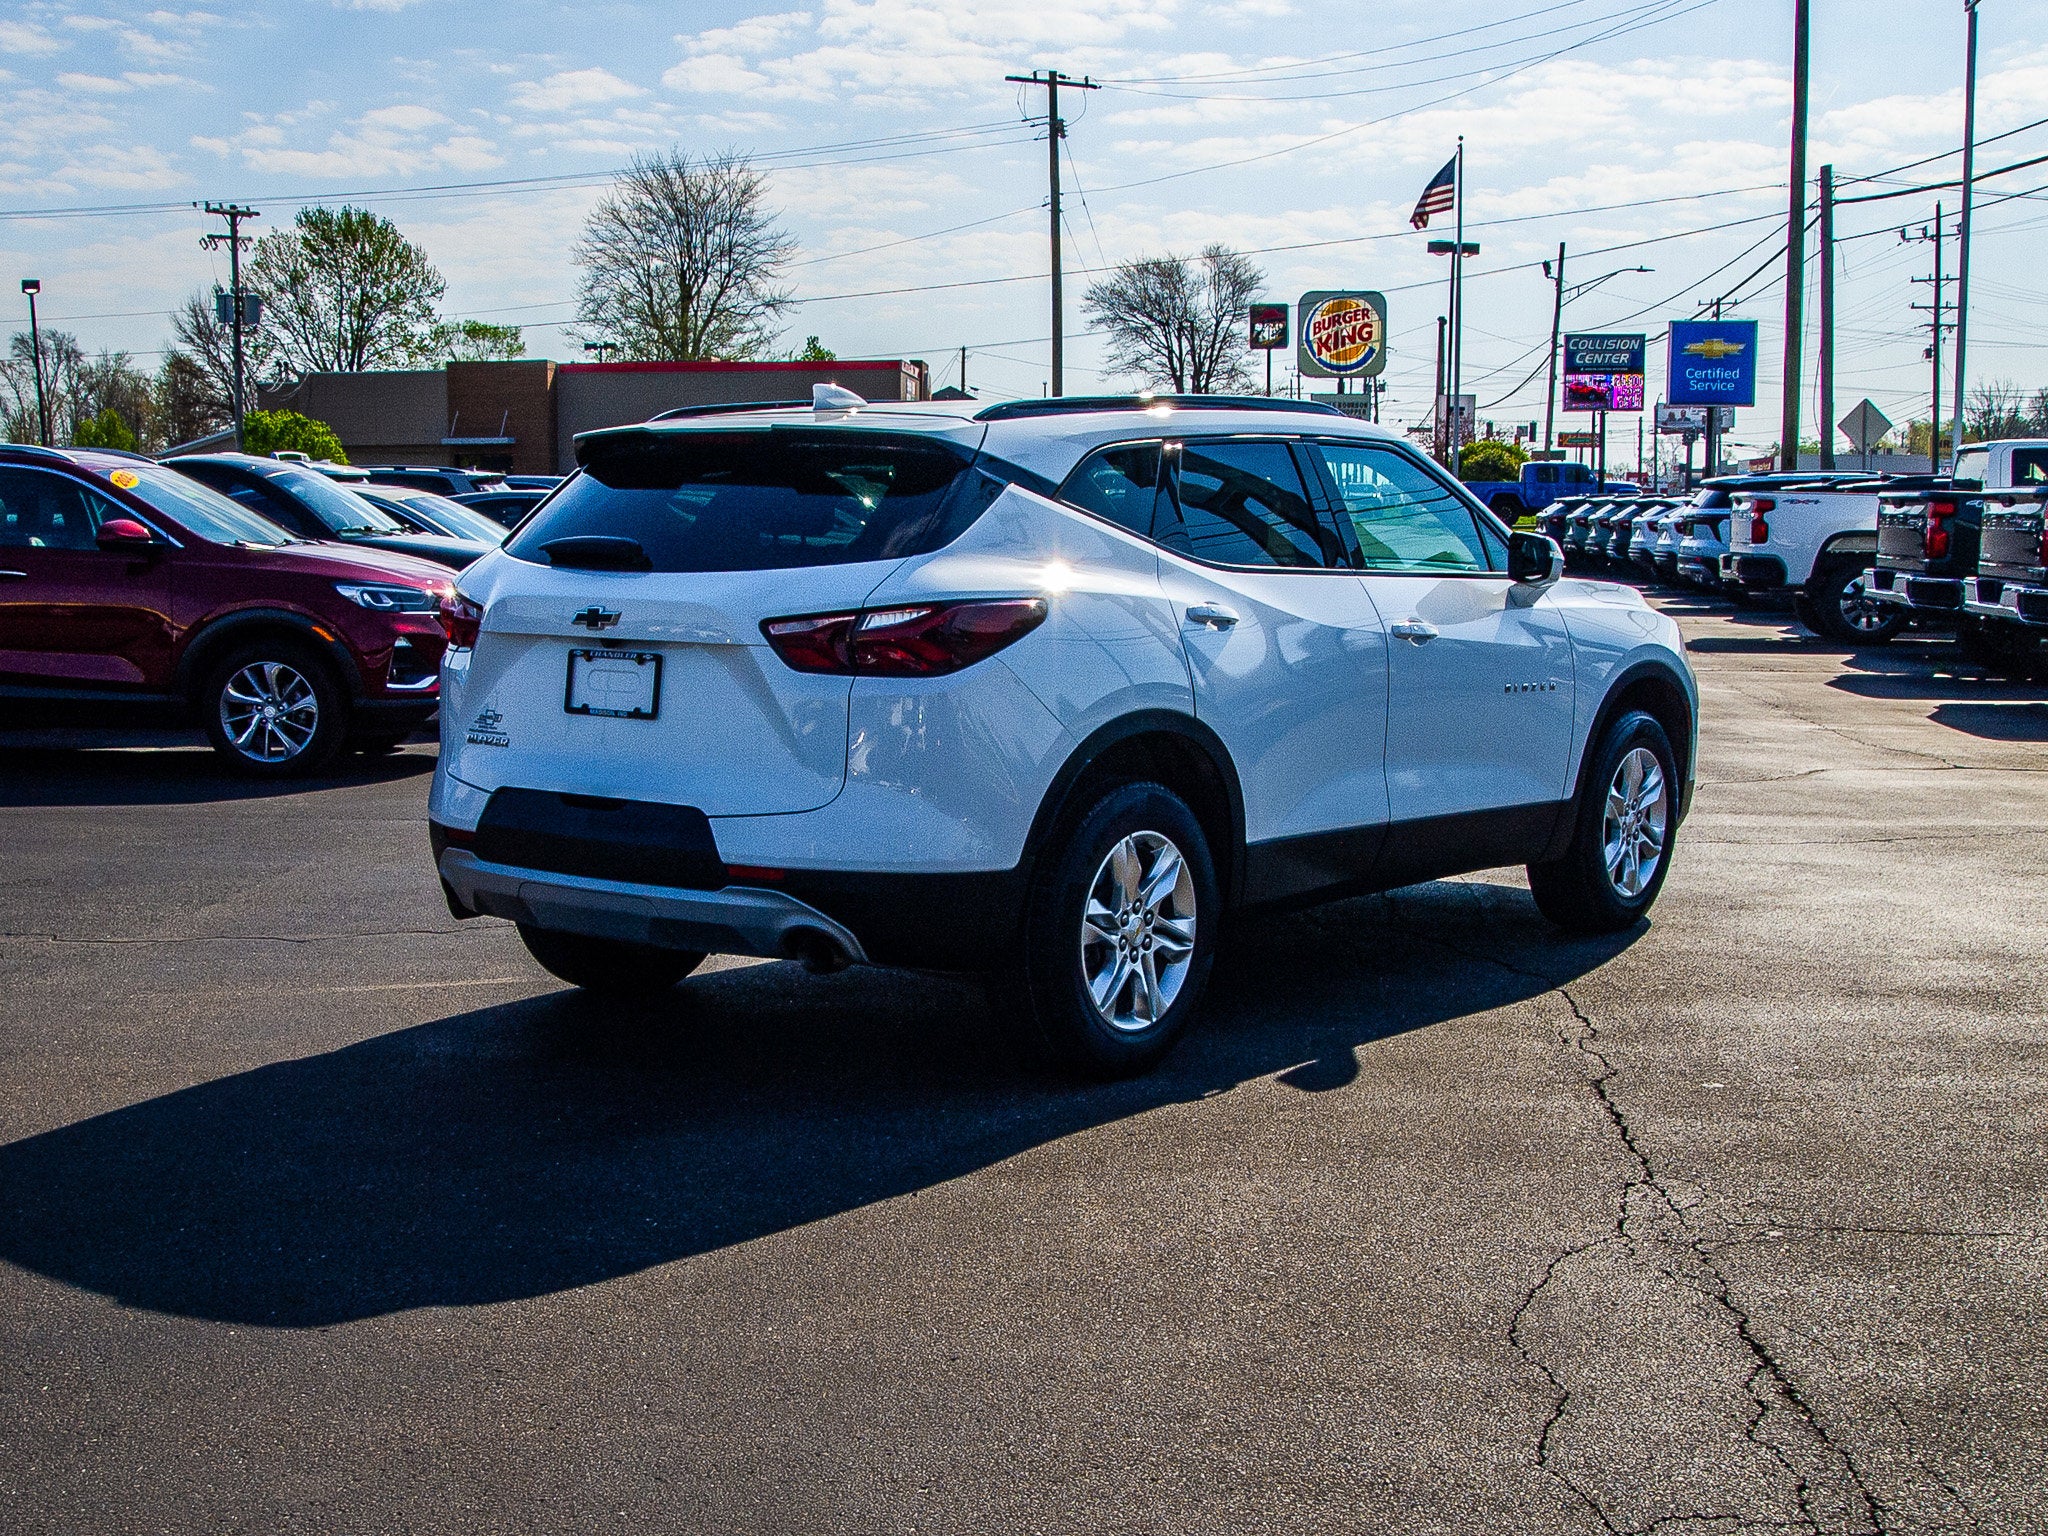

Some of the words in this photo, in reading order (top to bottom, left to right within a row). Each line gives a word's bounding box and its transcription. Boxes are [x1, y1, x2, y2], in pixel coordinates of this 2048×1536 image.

[1312, 308, 1371, 337] BURGER
[1316, 322, 1374, 356] KING
[1569, 338, 1640, 350] COLLISION
[1575, 352, 1630, 364] CENTER
[1685, 367, 1740, 379] Certified
[1689, 380, 1735, 391] Service
